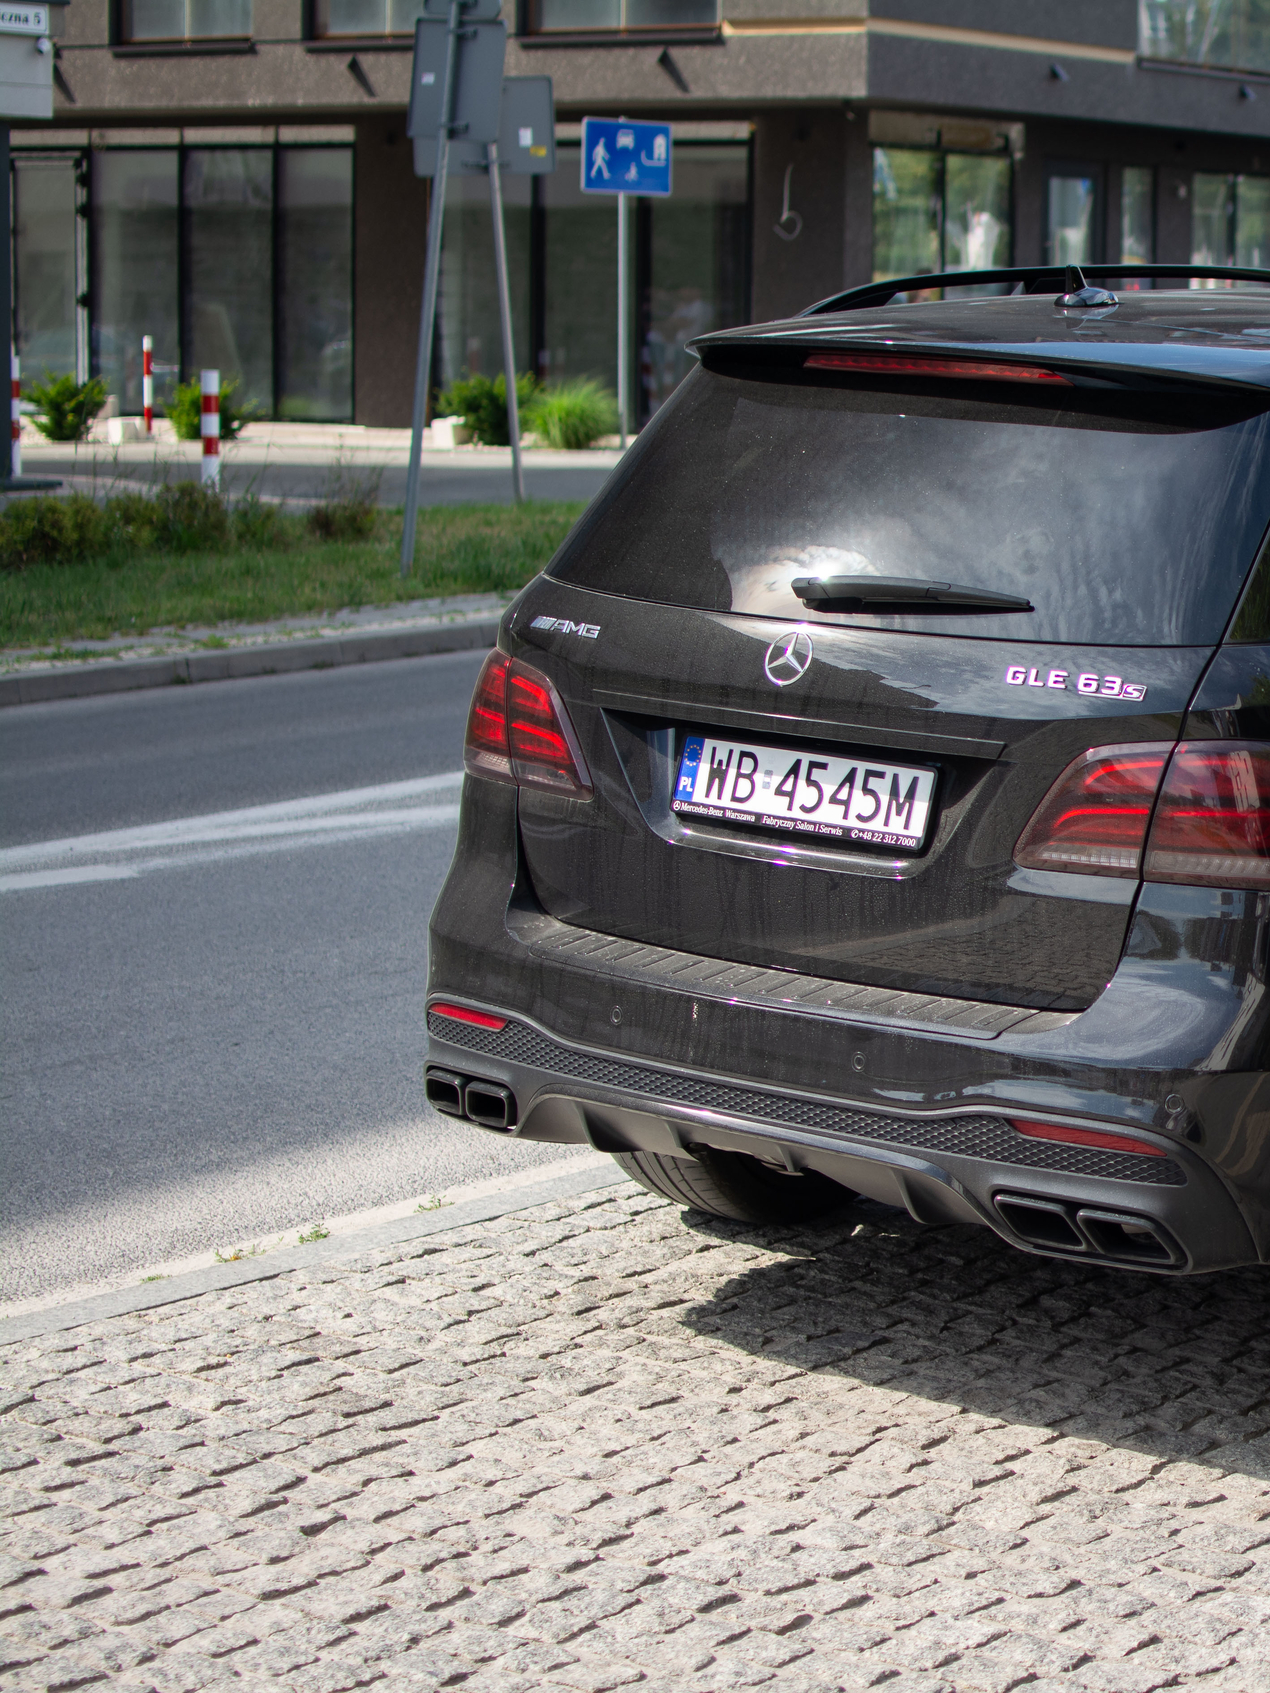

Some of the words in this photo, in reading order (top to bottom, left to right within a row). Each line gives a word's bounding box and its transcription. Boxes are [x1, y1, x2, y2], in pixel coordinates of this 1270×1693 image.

[34, 12, 41, 26] 5
[550, 618, 602, 639] AMG
[1006, 665, 1070, 690] GLE
[679, 776, 693, 793] PL
[704, 746, 759, 804] WB
[774, 758, 920, 831] 4545M
[680, 802, 724, 818] Mercedes-Benz
[725, 809, 756, 823] Warszawa
[762, 815, 796, 831] Fabryczny
[796, 820, 815, 832] Salon
[819, 824, 843, 836] Serwis
[858, 831, 872, 841] +48
[873, 832, 883, 842] 22
[884, 833, 896, 844] 312
[897, 836, 916, 847] 7000
